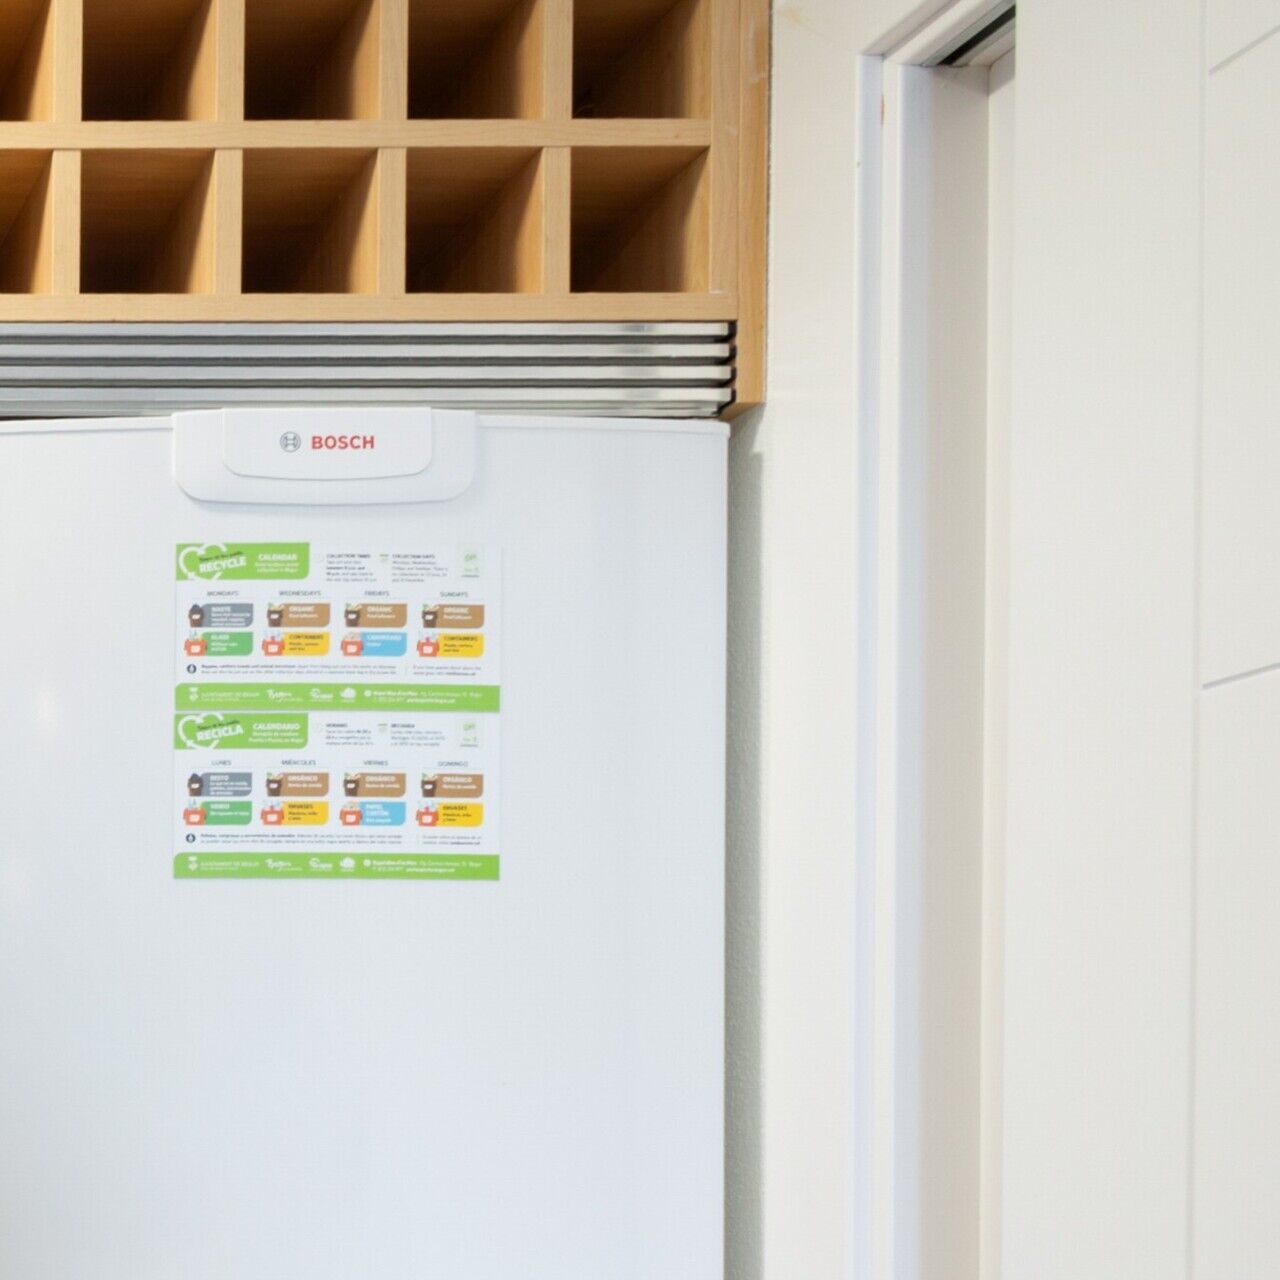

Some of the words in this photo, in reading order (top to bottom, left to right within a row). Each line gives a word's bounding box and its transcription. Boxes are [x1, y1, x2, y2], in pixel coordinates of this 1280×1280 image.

[311, 435, 375, 450] BOSCH
[199, 556, 248, 574] RECYCLE
[258, 553, 299, 561] CALENDAR
[196, 724, 244, 741] RECICLA
